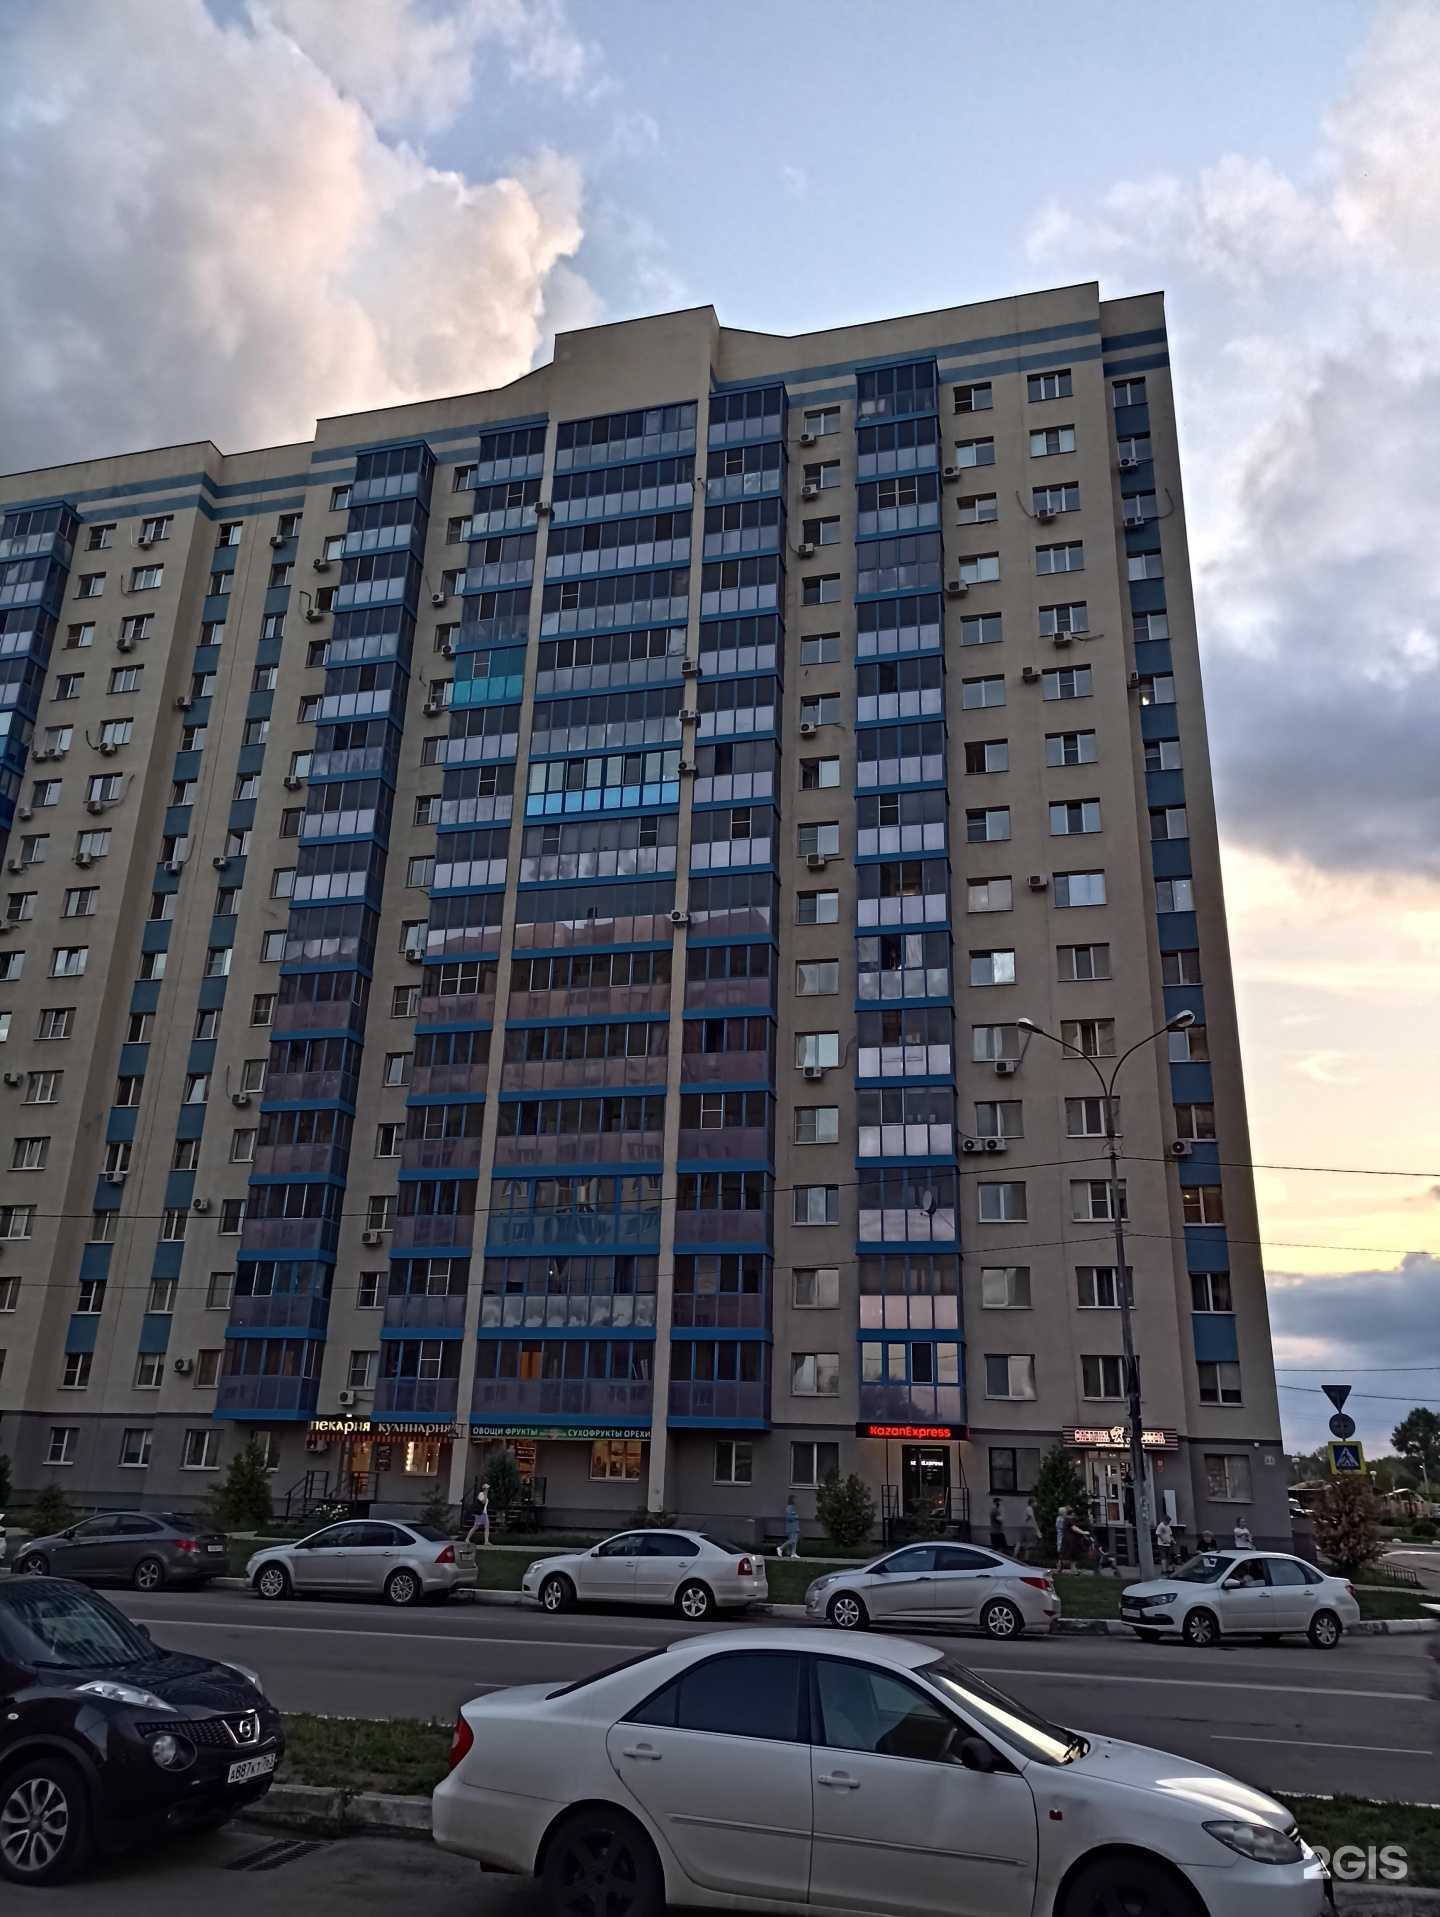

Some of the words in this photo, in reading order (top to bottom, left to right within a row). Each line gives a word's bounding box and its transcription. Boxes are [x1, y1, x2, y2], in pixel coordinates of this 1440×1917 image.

[472, 1426, 503, 1436] ОВОЩИ
[504, 1427, 538, 1437] ФРУКТЫ
[567, 1429, 622, 1438] СУХОФРУКТЫ
[624, 1431, 652, 1439] ОРЕХИ
[869, 1425, 951, 1438] KazanExpress
